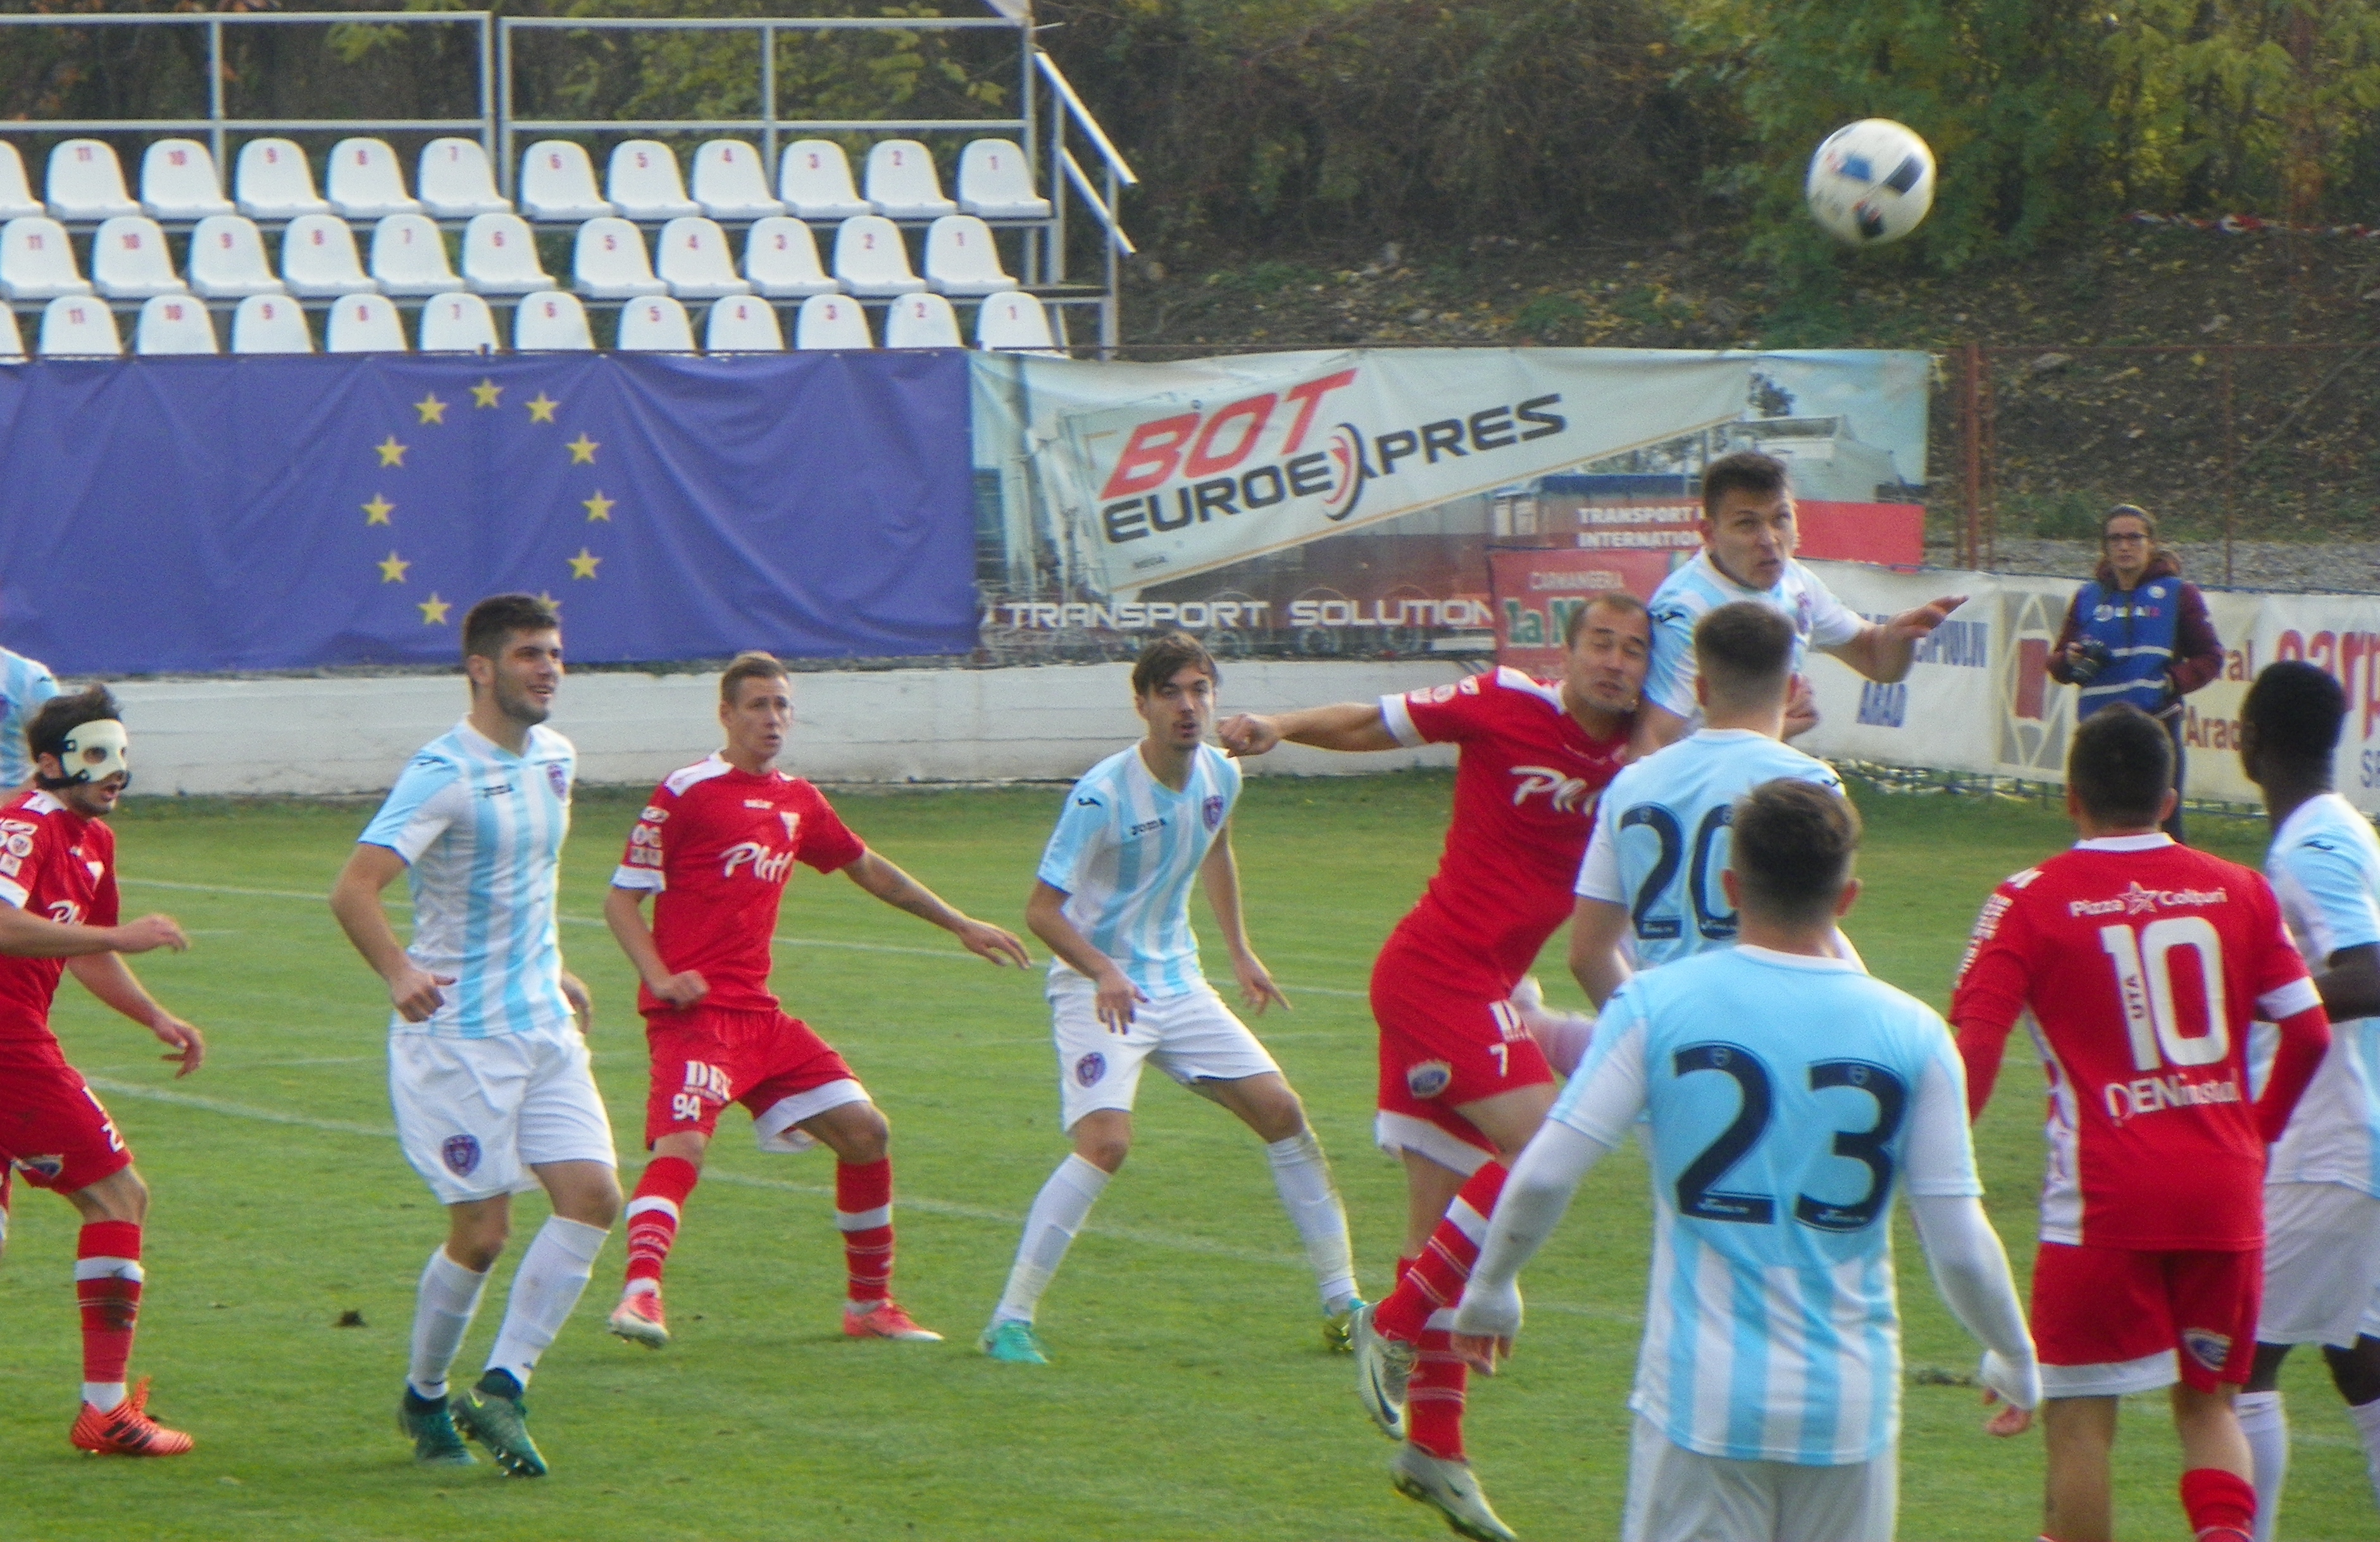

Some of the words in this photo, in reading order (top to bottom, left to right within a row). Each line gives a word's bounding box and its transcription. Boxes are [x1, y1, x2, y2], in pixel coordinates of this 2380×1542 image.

[550, 154, 562, 170] 6
[637, 152, 649, 168] 5
[722, 147, 733, 162] 4
[809, 153, 820, 169] 3
[892, 150, 904, 165] 2
[989, 155, 999, 170] 1
[493, 231, 504, 247] 6
[605, 234, 617, 251] 5
[688, 234, 699, 249] 4
[775, 234, 786, 249] 3
[864, 233, 875, 249] 2
[956, 232, 965, 247] 1
[545, 302, 557, 318] 6
[650, 306, 661, 322] 5
[736, 305, 747, 320] 4
[826, 305, 837, 320] 3
[916, 303, 926, 318] 2
[1009, 305, 1018, 320] 1
[1100, 368, 1359, 500] BOT
[1578, 506, 1693, 523] TRANSPORT
[1002, 601, 1271, 629] TRANSPORT
[1289, 598, 1494, 627] SOLUTION
[2099, 915, 2230, 1072] 10
[1488, 1042, 1509, 1077] 7
[672, 1093, 701, 1123] 94
[1673, 1039, 1908, 1233] 23
